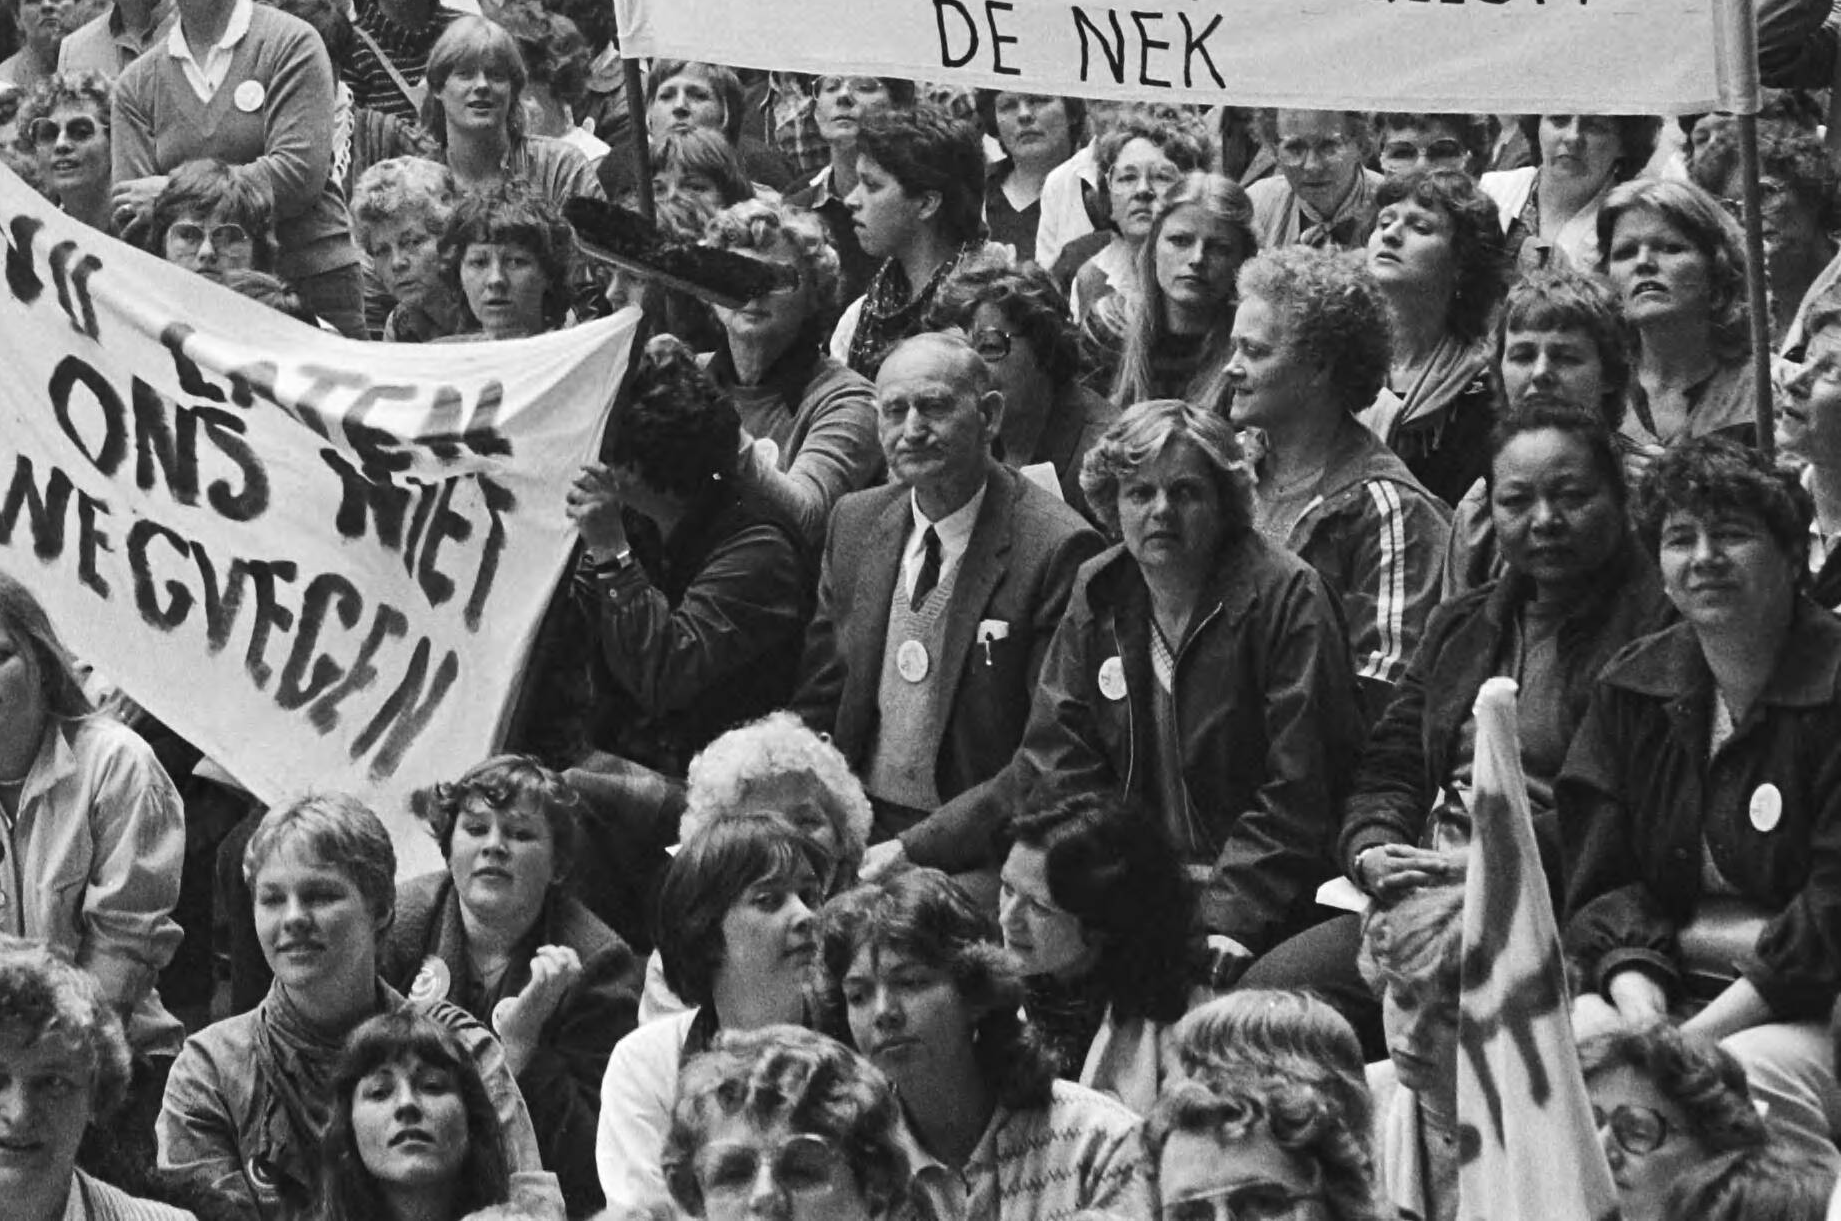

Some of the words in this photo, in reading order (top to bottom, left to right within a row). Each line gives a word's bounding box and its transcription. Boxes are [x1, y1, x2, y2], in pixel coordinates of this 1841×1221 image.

[1074, 9, 1229, 90] NEK
[48, 353, 271, 523] ONS
[319, 446, 516, 633] NIET
